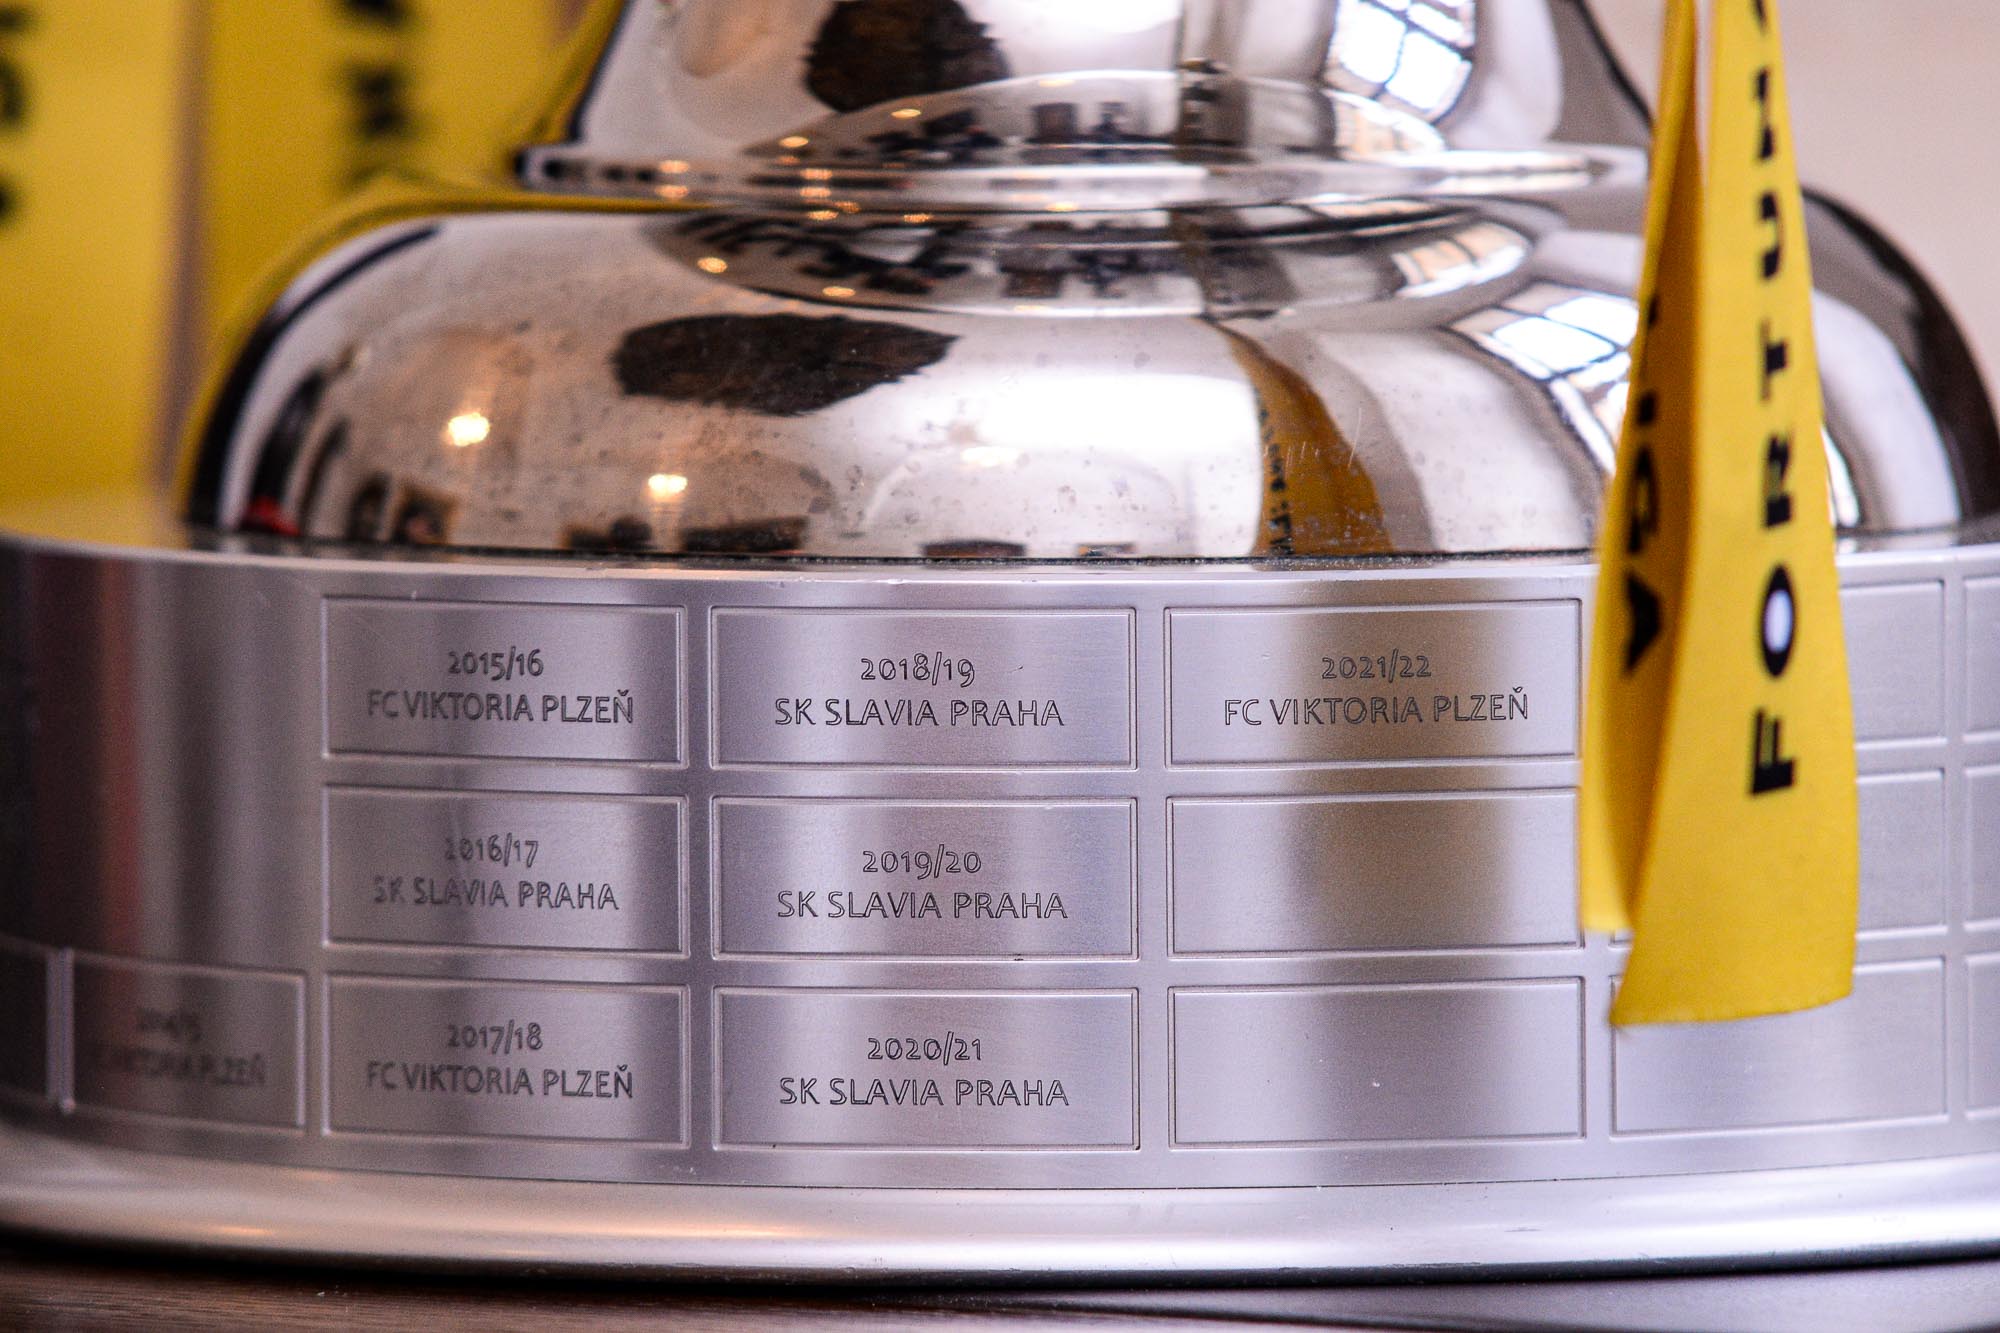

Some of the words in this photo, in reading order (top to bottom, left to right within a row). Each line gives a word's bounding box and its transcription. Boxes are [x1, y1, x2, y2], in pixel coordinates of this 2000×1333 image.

[448, 646, 544, 681] 2015/16
[860, 651, 975, 687] 2018/19
[1321, 648, 1432, 683] 2021/22
[366, 688, 399, 718] FC
[403, 690, 534, 722] VIKTORIA
[541, 689, 633, 724] PLZEŇ
[774, 698, 816, 726] SK
[825, 698, 939, 727] SLAVIA
[950, 699, 1065, 727] PRAHA
[1224, 699, 1262, 726] FC
[1269, 696, 1423, 726] VIKTORIA
[1433, 686, 1528, 722] PLZEŇ
[446, 832, 539, 868] 2016/17
[862, 844, 982, 880] 2019/20
[413, 876, 509, 908] SLAVIA
[518, 880, 620, 910] PRAHA
[777, 890, 819, 918] SK
[827, 891, 942, 919] SLAVIA
[953, 892, 1068, 919] PRAHA
[448, 1019, 544, 1055] 2017/18
[867, 1031, 983, 1066] 2020/21
[366, 1060, 396, 1090] FC
[402, 1061, 534, 1096] VIKTORIA
[542, 1064, 633, 1099] PLZEŇ
[779, 1077, 820, 1105] SK
[829, 1077, 944, 1106] SLAVIA
[954, 1079, 1070, 1106] PRAHA
